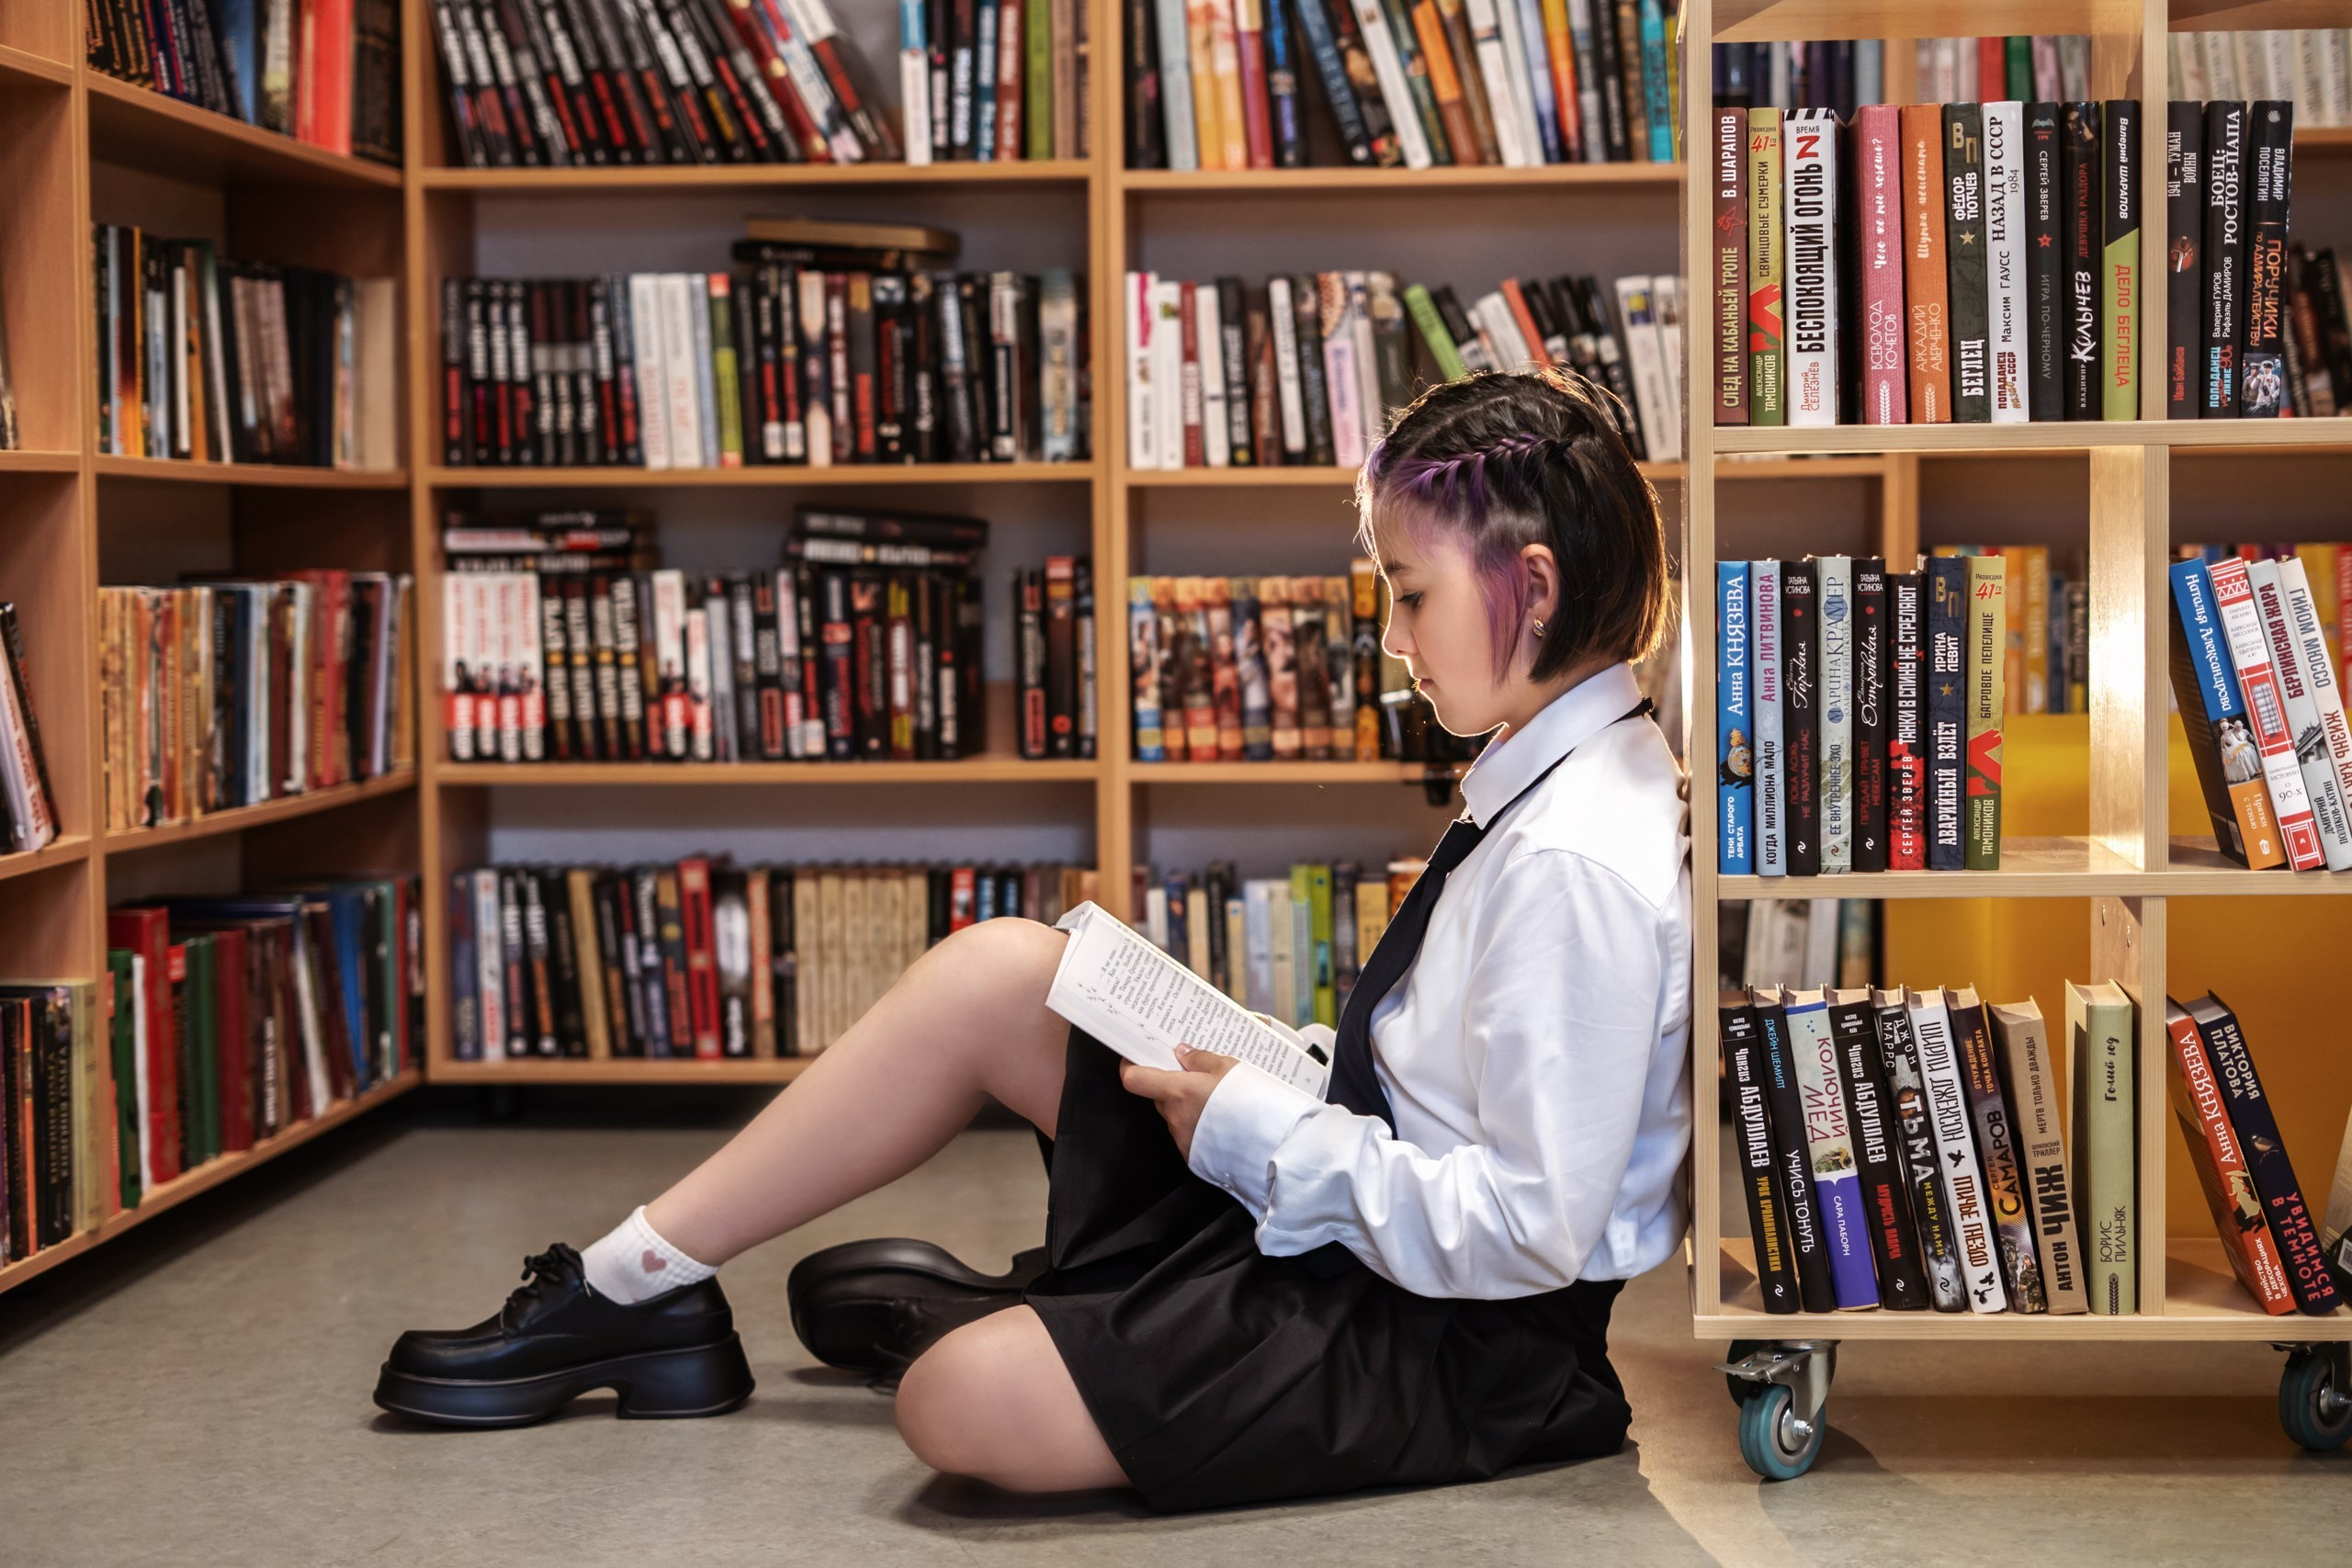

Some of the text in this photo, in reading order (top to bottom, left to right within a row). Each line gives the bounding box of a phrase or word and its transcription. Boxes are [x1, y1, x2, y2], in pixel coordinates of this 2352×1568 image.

[1722, 116, 1736, 182] ШАРАПОВ
[1990, 116, 2007, 242] НАЗАД В СССР
[2010, 169, 2019, 193] 1984
[2039, 151, 2050, 185] СЕРГЕЙ
[2120, 118, 2129, 219] Валерий ШАРАПОВ
[2168, 131, 2181, 197] 1941 ТУМАН
[2184, 152, 2197, 184] ВОЙНЫ
[2211, 149, 2227, 207] БОЕЦ:
[2224, 110, 2240, 244] РОСТОВ-ПАПА
[2258, 147, 2270, 201] ПОСЕЛЯГИН
[2274, 148, 2284, 200] ВЛАДИМИР
[1759, 161, 1770, 276] СВИНЦОВЫЕ СУМЕРКИ
[1952, 176, 1965, 220] ФЁДОР
[1967, 172, 1979, 220] ТЮТЧЕВ
[2040, 187, 2049, 220] ЗВЕРЕВ
[2077, 163, 2088, 258] ДЕВУШКА РАЗДОРА
[1790, 164, 1828, 353] БЕСПОКОЯЩИЙ ОГОНЬ
[1917, 213, 1930, 258] Шутка
[1718, 247, 1739, 407] СЛЕД НА КАБАНЬЕЙ ТРОПЕ
[2000, 251, 2011, 343] Максим ГАУСС
[2115, 265, 2131, 388] ДЕЛО БЕГЛЕЦА
[2212, 272, 2222, 338] Валерий ГУРОВ
[2222, 256, 2232, 338] Рафаэль ДАМИРОВ
[1871, 299, 1883, 369] ВСЕВОЛОД
[1886, 314, 1896, 369] КОЧЕТОВ
[1916, 305, 1928, 372] АРКАДИЙ
[1930, 302, 1941, 371] АВЕРЧЕНКО
[2041, 305, 2051, 378] ПО-ЧЕРНОМУ
[1765, 355, 1776, 412] ТАМОНИКОВ
[1801, 371, 1811, 411] Дмитрий
[1811, 361, 1819, 411] СЕЛЕЗНЁВ
[1962, 339, 1984, 397] БЕГЛЕЦ
[1998, 351, 2007, 409] ПОПАДАНЕЦ
[2173, 346, 2185, 400] Иван Байбаков
[2210, 347, 2221, 408] ПОПАДАНЕЦ
[1785, 585, 1811, 594] УСТИНОВА
[1788, 576, 1808, 585] ТАТЬЯНА
[1858, 583, 1883, 592] УСТИНОВА
[1860, 574, 1880, 582] ТАТЬЯНА
[1727, 575, 1745, 716] Анна КНЯЗЕВА
[1759, 574, 1775, 703] Анна ЛИТВИНОВА
[1898, 586, 1917, 745] ТАНКИ В СПИНУ НЕ СТРЕЛЯЮТ
[1935, 633, 1946, 672] ИРИНА
[1948, 636, 1959, 672] ЛЕВИТ
[1981, 612, 1994, 718] БАГРОВОЕ ПЕПЕЛИЩЕ
[2186, 573, 2232, 712] Наталья Александрова
[2258, 581, 2305, 700] БЕРЛИНСКАЯ ЖАРА
[2289, 588, 2331, 688] ГИЙОМ МЮССО
[1861, 625, 1878, 727] Островская
[1802, 728, 1810, 745] НАС
[2324, 709, 2350, 759] ЖИЗНЬ
[1766, 740, 1777, 864] КОГДА МИЛЛИОНА МАЛО
[1803, 803, 1810, 818] НЕ
[1830, 744, 1841, 835] ЕЕ ВНУТРЕННЕЕ ЭХО
[1860, 740, 1870, 826] ПЕРЕДАЙ ПРИВЕТ
[1899, 755, 1913, 855] СЕРГЕЙ ЗВЕРЕВ
[1933, 721, 1957, 846] АВАРИЙНЫЙ ВЗЛЁТ
[2253, 793, 2267, 829] Прятки
[2323, 780, 2347, 845] ПОЛЯКОВ-КАТИН
[1982, 799, 1995, 855] ТАМОНИКОВ
[2314, 795, 2334, 842] ДМИТРИЙ
[1764, 1018, 1785, 1089] ДЖЕЙН ШЕМИЛТ
[1883, 1022, 1894, 1067] МАРРС
[1894, 1019, 1917, 1065] ДЖОН
[1975, 1029, 1995, 1094] ТОЧКА КОНТАКТА
[2211, 1030, 2243, 1099] ПЛАТОВА
[2223, 1023, 2260, 1100] ВИКТОРИЯ
[1803, 1084, 1830, 1144] МЕД
[1817, 1036, 1850, 1138] КОЛЮЧИЙ
[1919, 1021, 1965, 1144] ШИРЛИ ДЖЕКСОН
[2025, 1036, 2048, 1134] МЕРТВ ТОЛЬКО ДВАЖДЫ
[2179, 1030, 2236, 1164] Анна КНЯЗЕВА
[1740, 1086, 1770, 1168] АБДУЛЛАЕВ
[1855, 1082, 1887, 1164] АБДУЛЛАЕВ
[1898, 1095, 1934, 1189] ТЬМА
[2032, 1146, 2061, 1157] ТРИЛЛЕР
[1986, 1110, 2022, 1216] САМАРОВ
[1986, 1156, 2000, 1191] СЕРГЕЙ
[1757, 1176, 1782, 1272] УРОК КРИМИНАЛИСТИКИ
[1786, 1150, 1815, 1253] УЧИСЬ ТОНУТЬ
[1834, 1195, 1850, 1257] САРА ПАБОРН
[1924, 1182, 1945, 1257] МЕЖДУ НАМИ
[1953, 1176, 1988, 1268] ПТИЧЬЕ ГНЕЗДО
[2034, 1164, 2073, 1292] АНТОН ЧИХ
[2115, 1205, 2126, 1262] ПИЛЬНЯК
[2100, 1221, 2113, 1262] БОРИС
[2255, 1237, 2278, 1291] ДЕКОРАЦИЯХ
[2272, 1197, 2321, 1302] В ТЕМНОТЕ
[2286, 1191, 2335, 1298] УВИДИМСЯ
[2255, 1259, 2273, 1302] УБИЙСТВО
[2274, 1265, 2289, 1298] ЧЕХОВА
